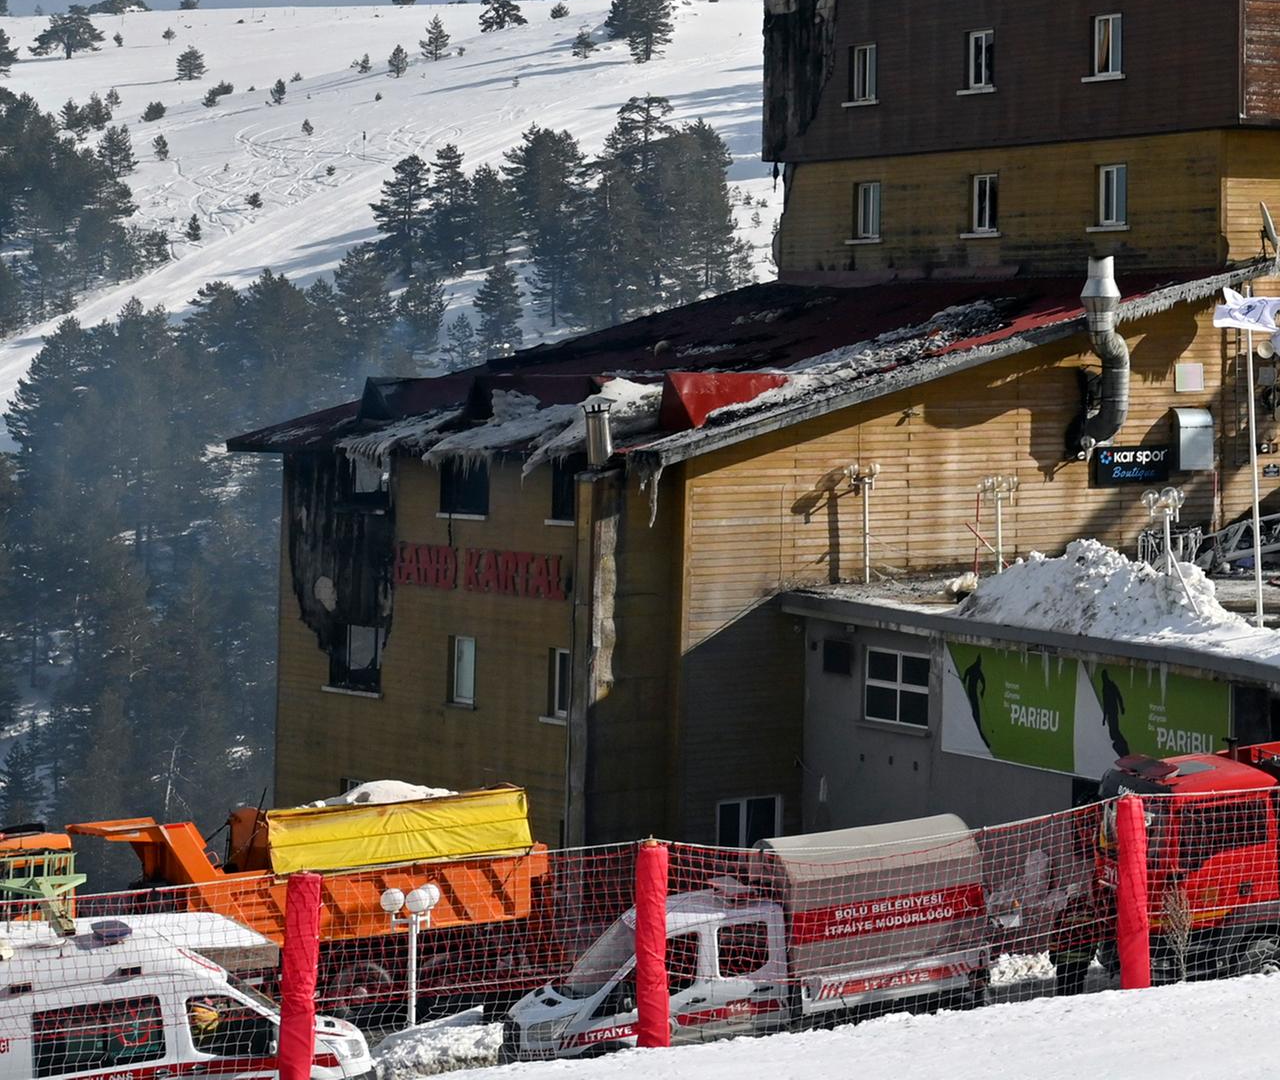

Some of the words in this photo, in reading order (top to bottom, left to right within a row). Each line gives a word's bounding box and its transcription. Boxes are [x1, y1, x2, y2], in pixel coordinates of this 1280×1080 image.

[1136, 450, 1165, 465] spor
[463, 548, 566, 601] KARTAL
[835, 904, 868, 921] BOLU
[872, 893, 943, 914] BELEDİYESİ
[825, 921, 872, 937] İTFAİYE
[876, 907, 953, 929] MÜDÜRLÜĞÜ
[864, 971, 931, 992] İTFAİYE
[728, 1001, 750, 1013] 112
[585, 1024, 633, 1043] İTFAİYE
